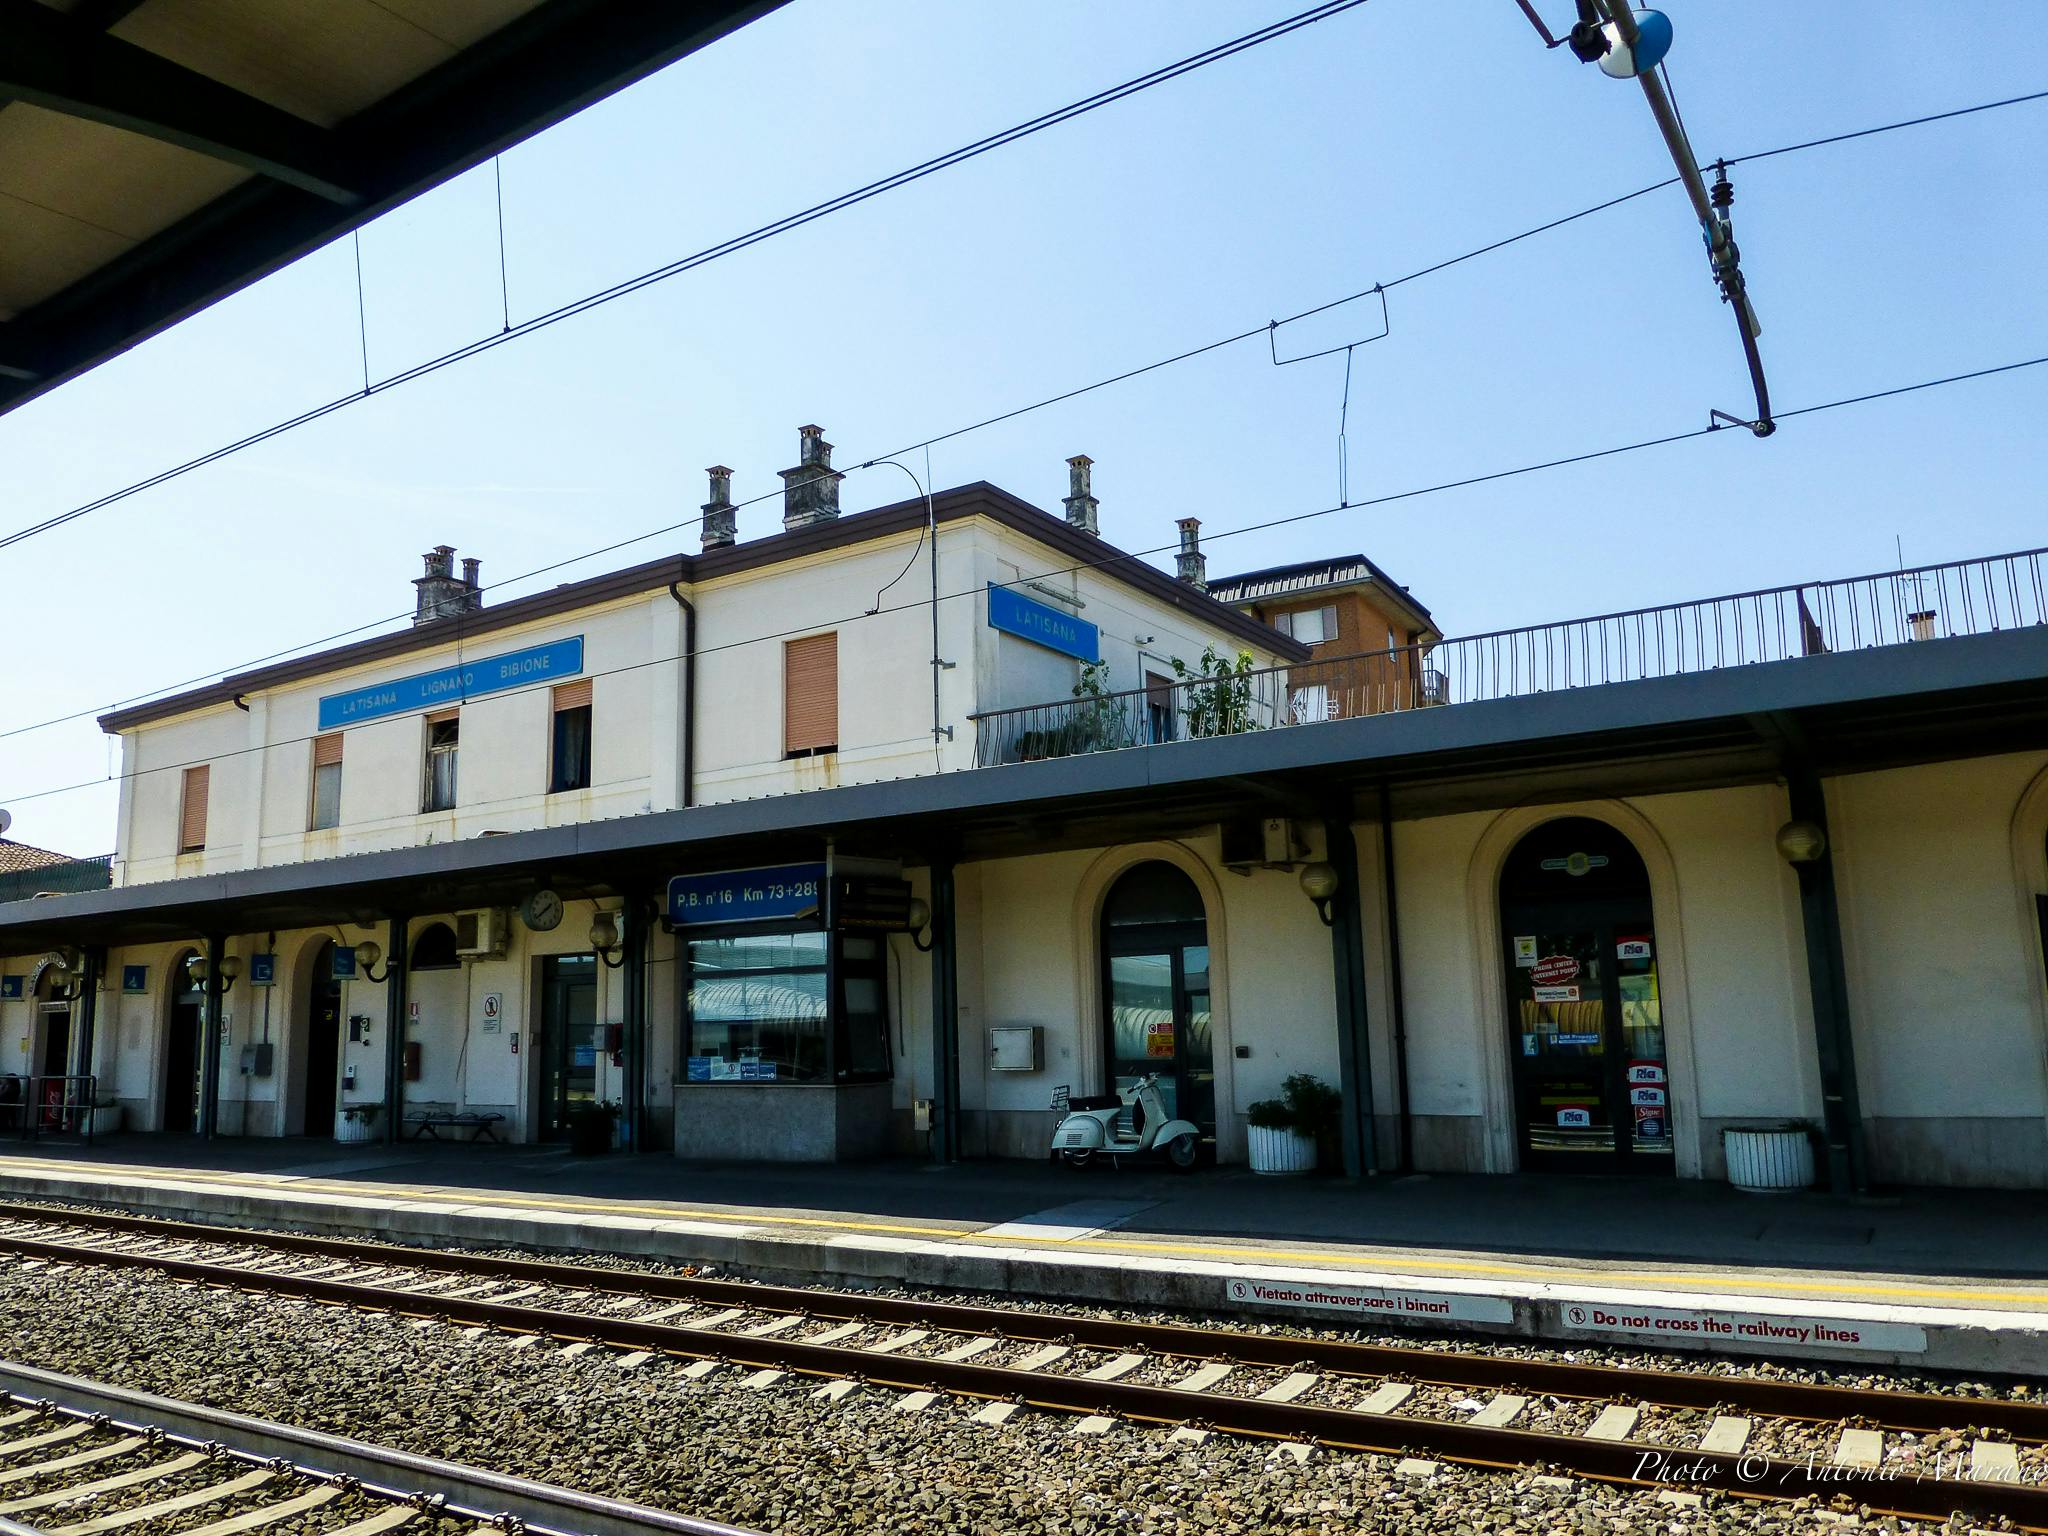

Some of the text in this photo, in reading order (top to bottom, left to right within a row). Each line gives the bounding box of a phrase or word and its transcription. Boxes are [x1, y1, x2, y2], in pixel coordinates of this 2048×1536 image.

[1016, 606, 1076, 641] LATISANA
[342, 654, 550, 715] LATISANA LIGNANO BIBIONE
[677, 892, 702, 908] P.B.
[719, 889, 733, 904] 16
[744, 887, 764, 902] Km
[1623, 943, 1643, 955] Ria
[1636, 1068, 1656, 1079] Ria
[1638, 1090, 1657, 1101] Ria
[1563, 1111, 1584, 1122] Ria
[1252, 1286, 1450, 1314] Vietato attraversare i binari
[1592, 1311, 1860, 1343] Do not cross the railway lines
